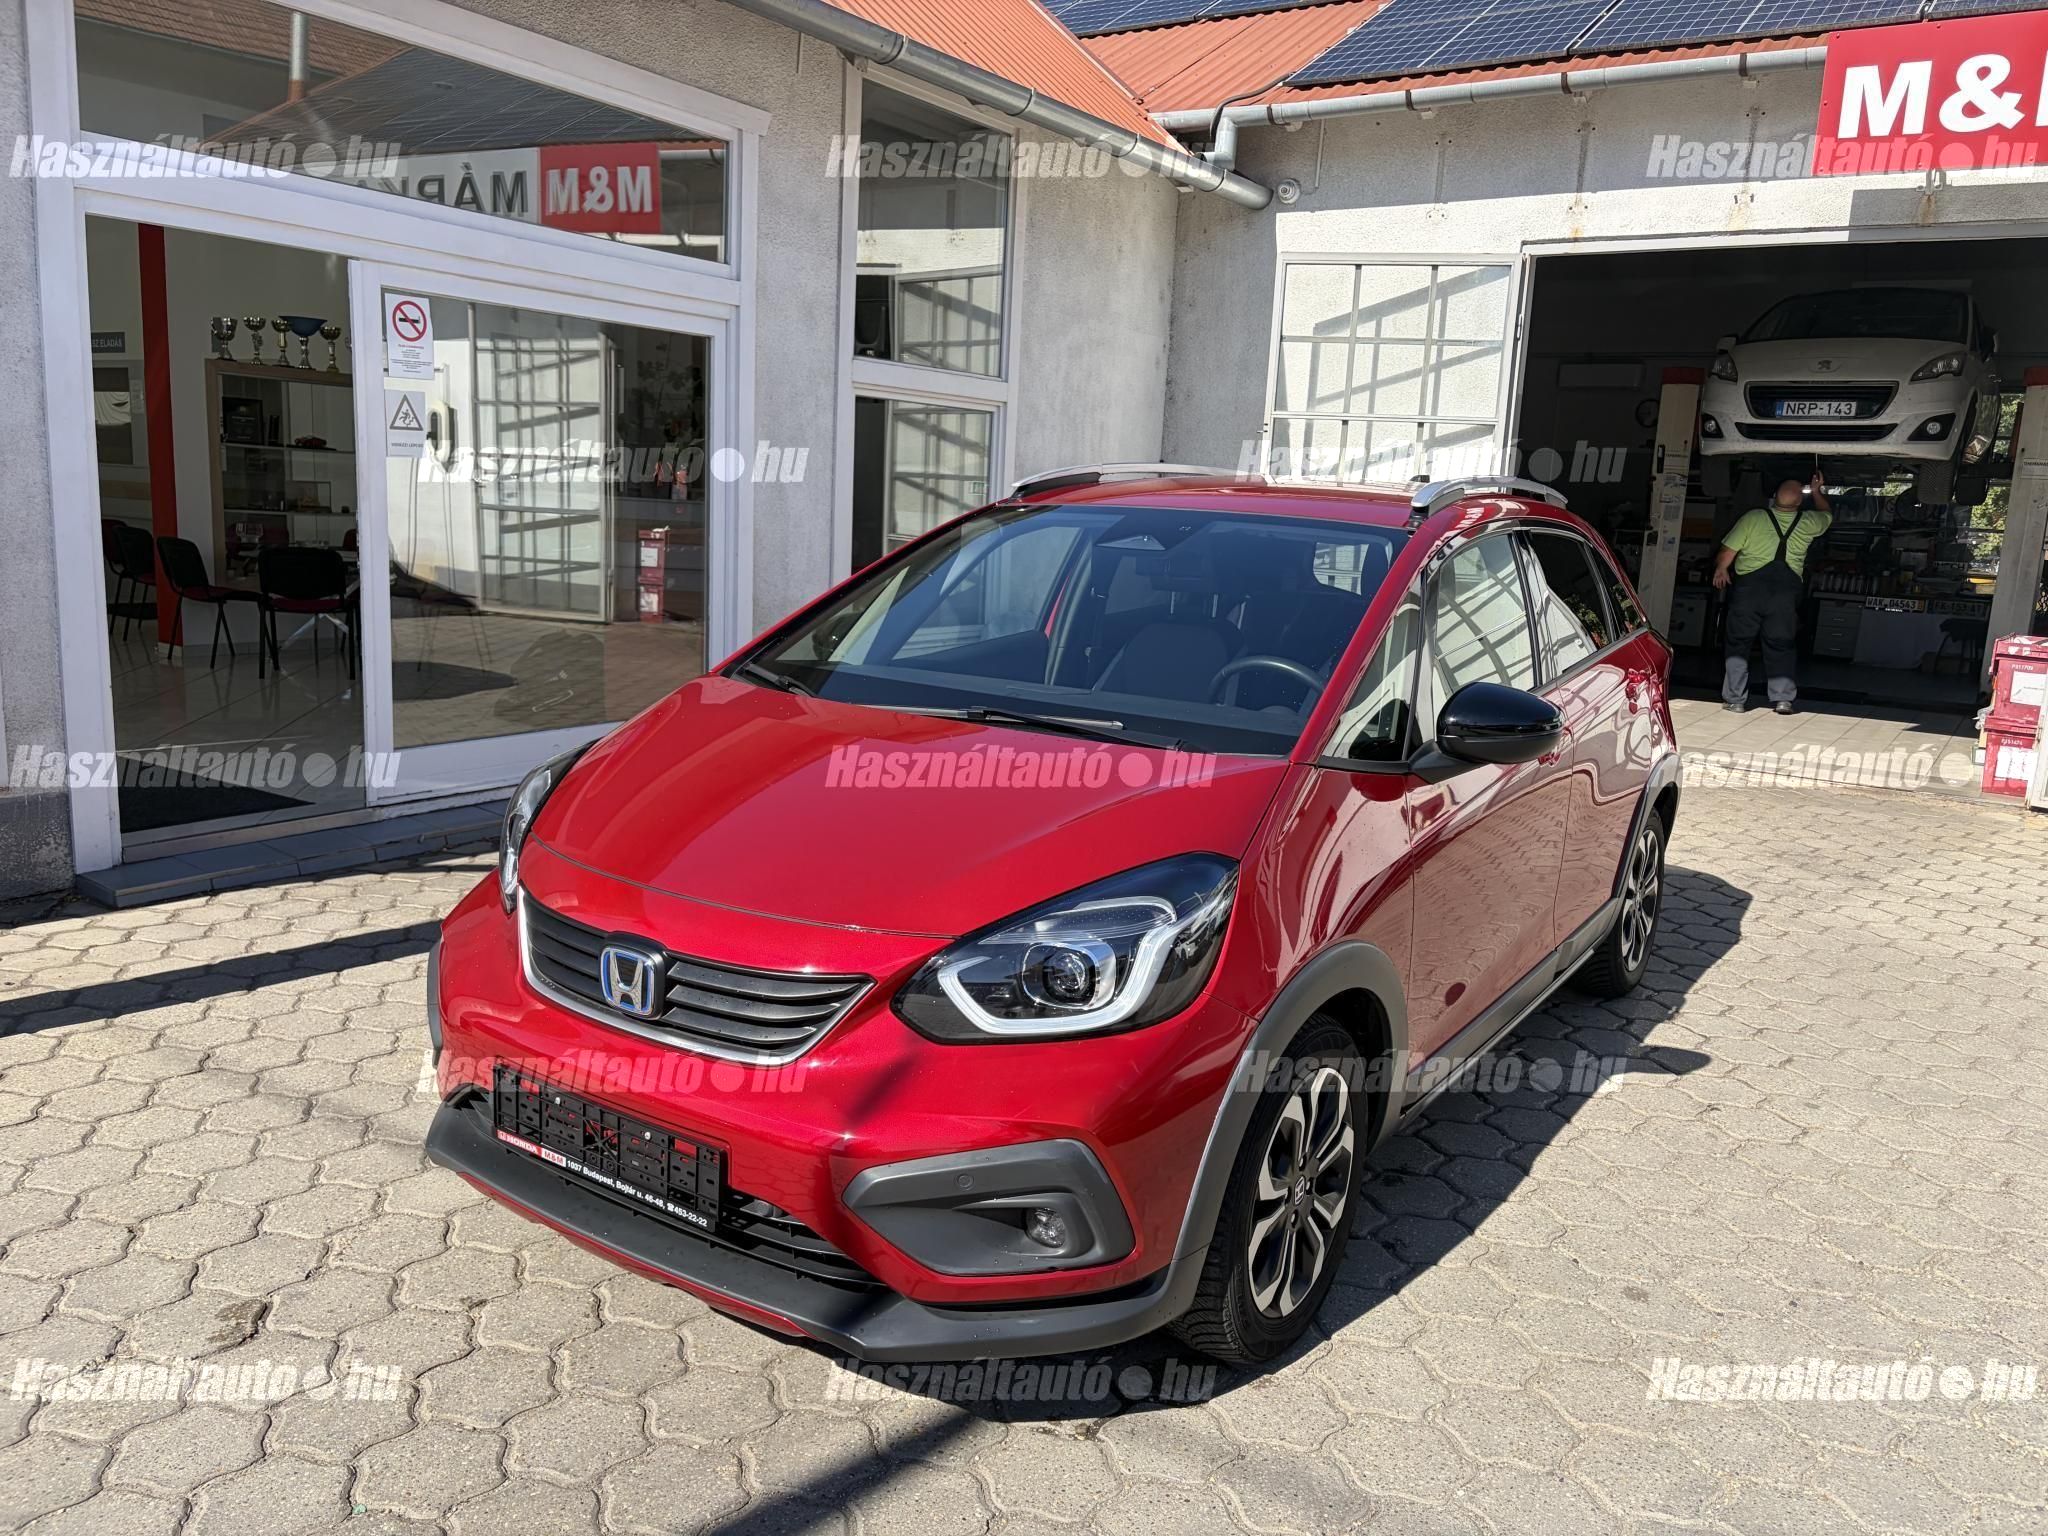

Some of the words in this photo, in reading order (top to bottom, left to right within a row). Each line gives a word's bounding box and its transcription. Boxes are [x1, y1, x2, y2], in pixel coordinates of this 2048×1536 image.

[1838, 50, 2048, 138] M&
[1785, 402, 1853, 415] NRP-143
[506, 1133, 538, 1154] HONDA
[567, 1160, 582, 1172] 1037
[583, 1165, 615, 1187] Budapest,
